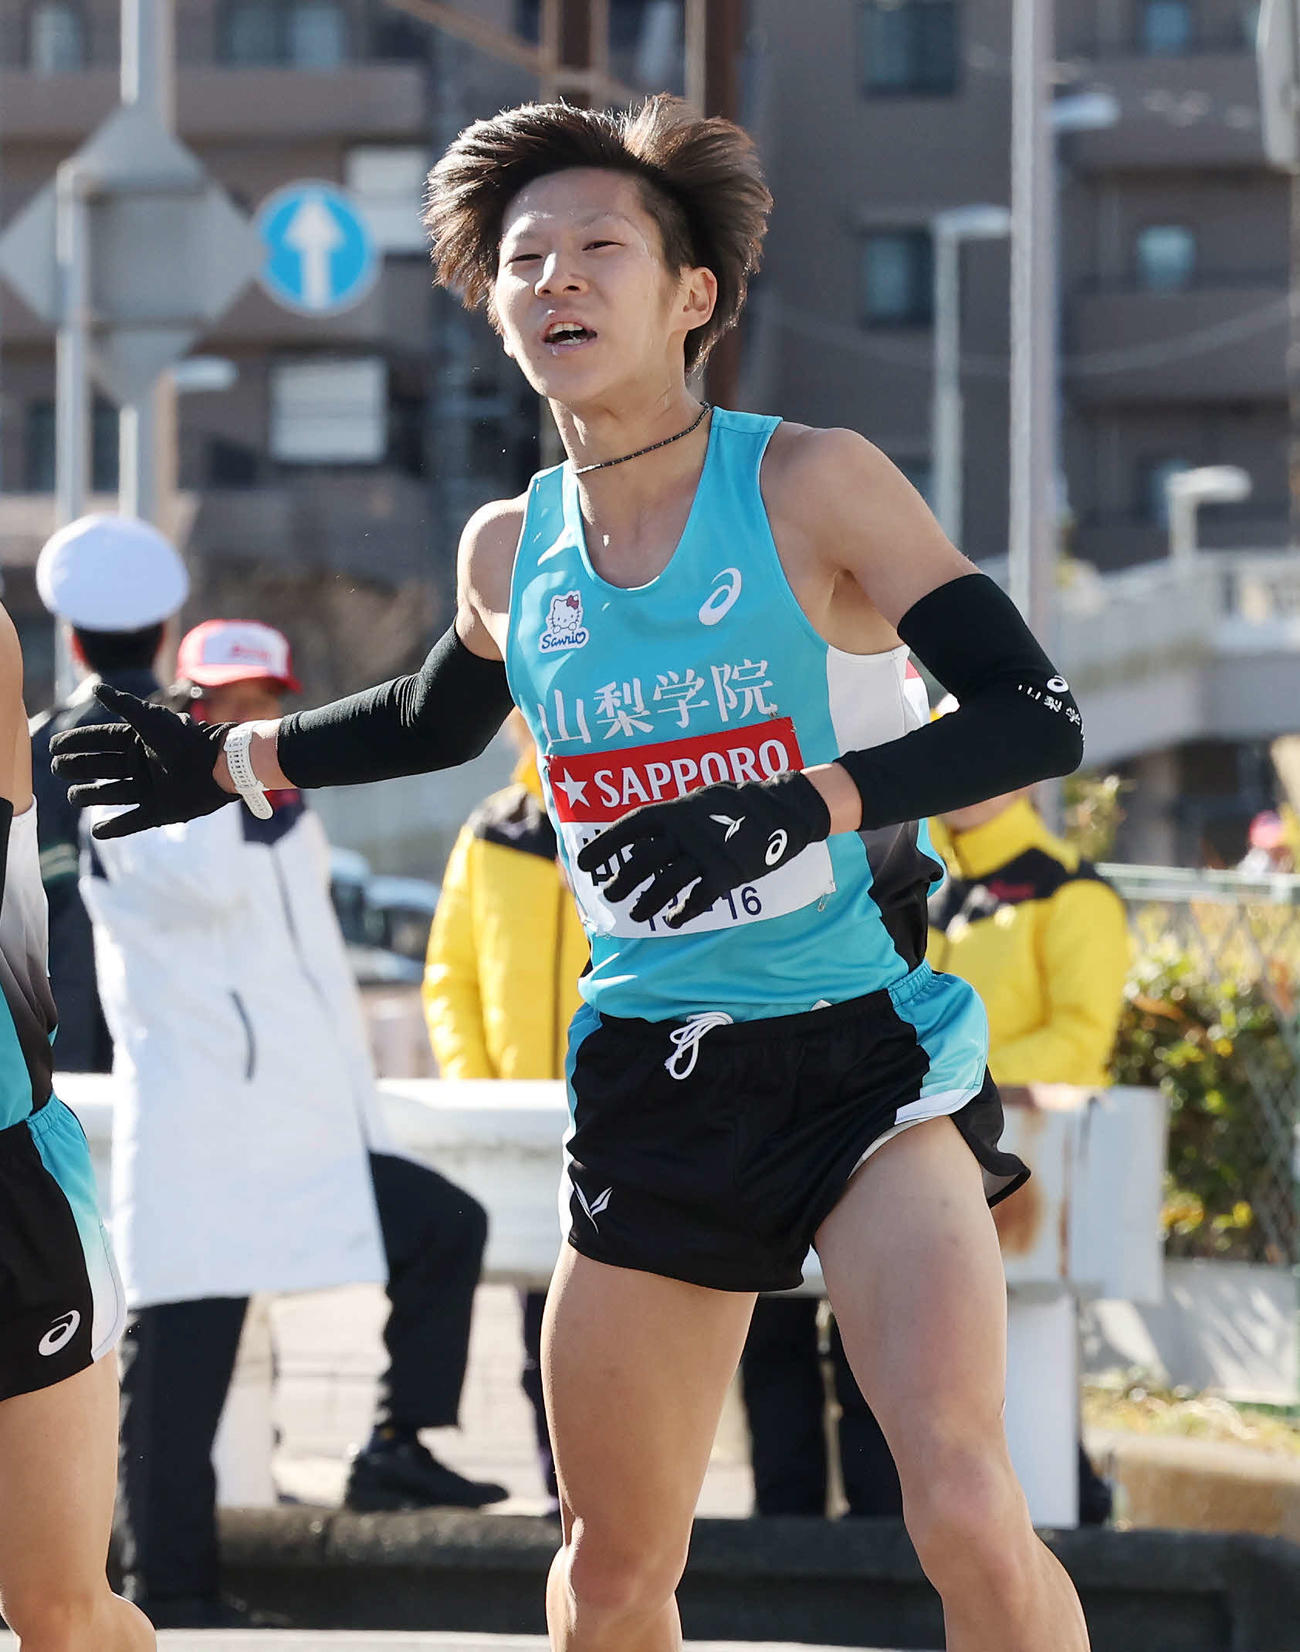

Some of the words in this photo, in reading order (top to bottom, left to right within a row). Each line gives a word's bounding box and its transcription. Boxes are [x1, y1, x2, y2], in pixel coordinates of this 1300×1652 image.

[537, 658, 778, 744] 山梨学院
[1017, 684, 1085, 743] 山梨学
[593, 739, 790, 808] SAPPORO
